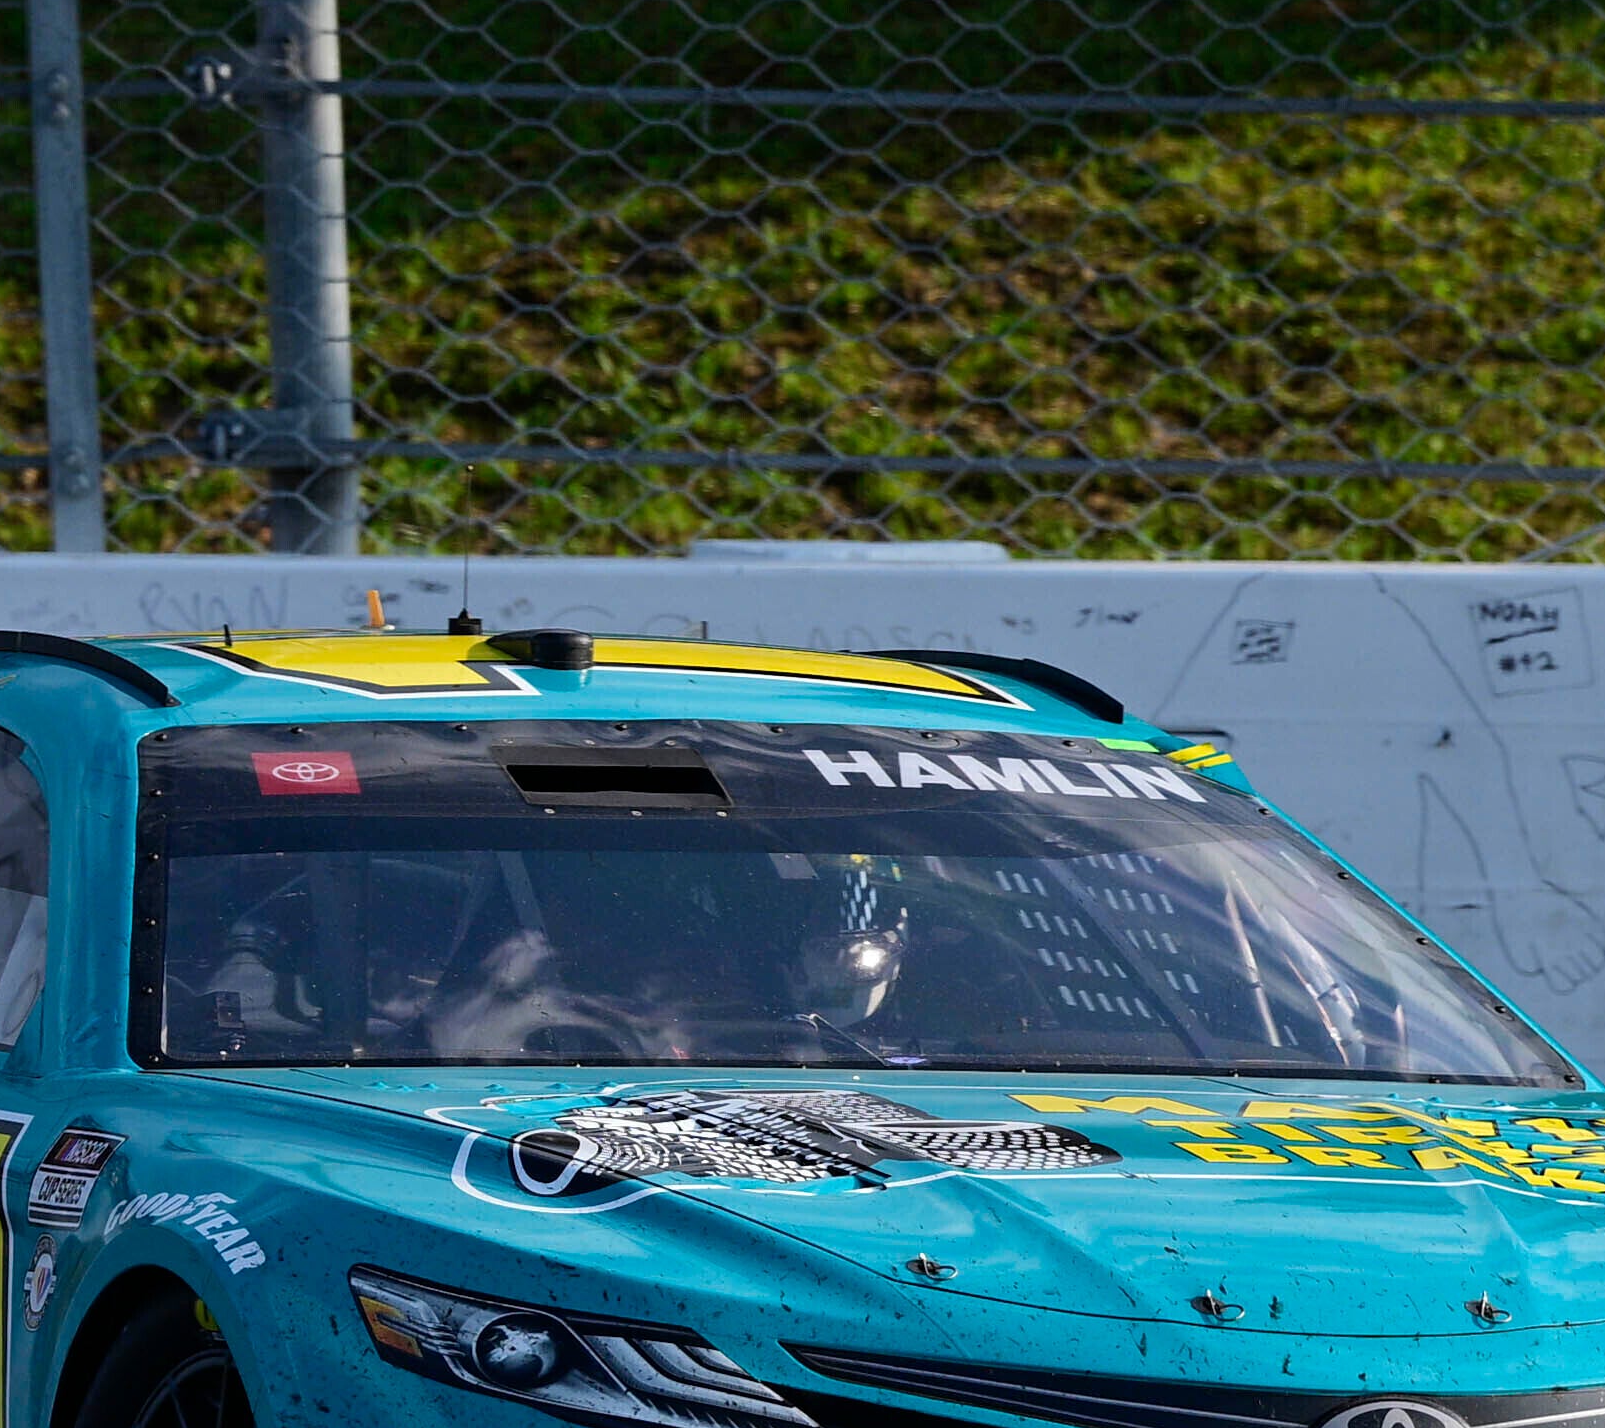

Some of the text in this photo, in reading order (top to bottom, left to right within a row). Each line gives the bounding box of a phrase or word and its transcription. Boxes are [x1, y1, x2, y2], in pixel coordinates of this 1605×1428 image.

[1477, 600, 1563, 624] NOAH
[803, 749, 1208, 803] HAMLIN
[38, 1174, 61, 1202] CUP
[102, 1192, 267, 1276] GOODYEAR
